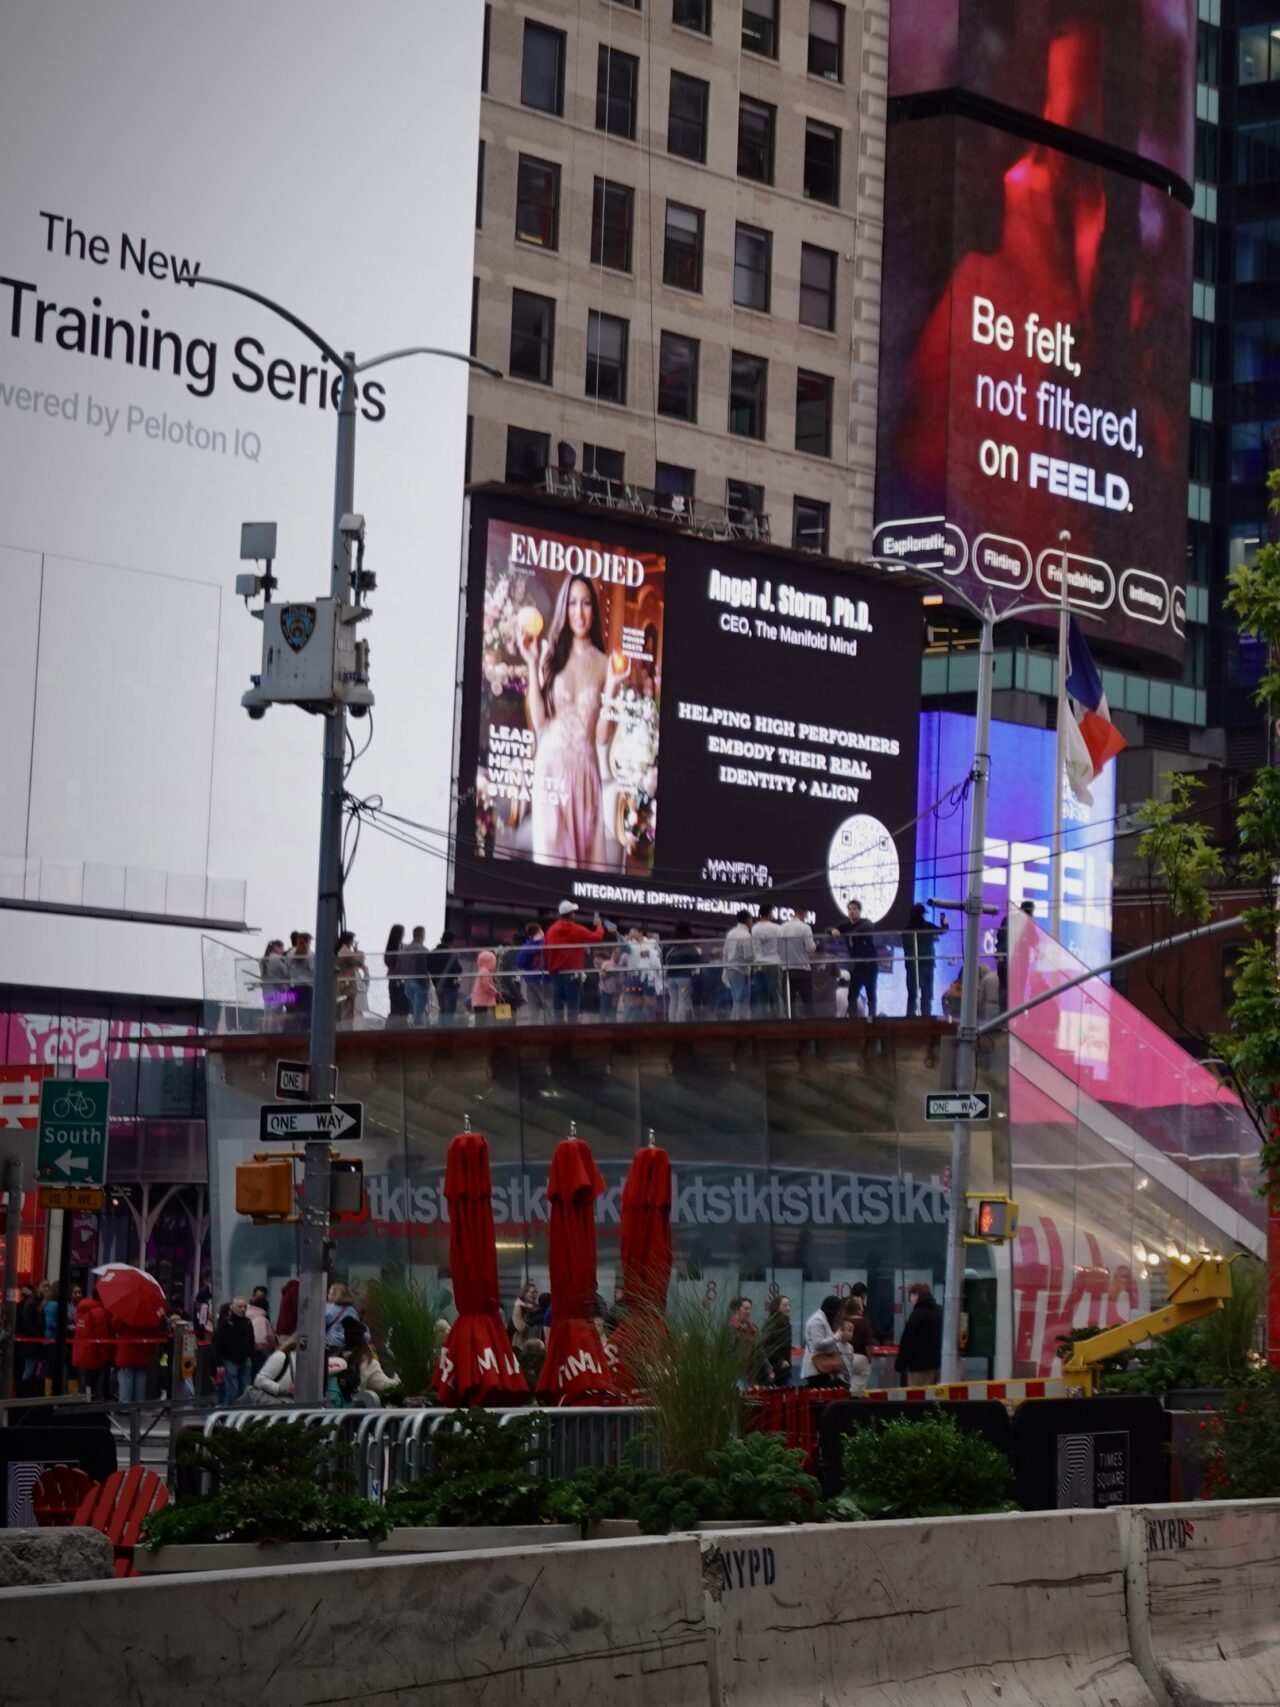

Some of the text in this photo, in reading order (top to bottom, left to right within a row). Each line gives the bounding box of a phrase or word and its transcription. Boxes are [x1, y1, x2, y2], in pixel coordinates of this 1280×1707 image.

[39, 210, 201, 287] The New
[0, 276, 217, 397] Training
[972, 296, 1081, 377] Be felt,
[87, 386, 119, 437] by
[127, 405, 227, 455] Peloton
[235, 430, 262, 464] IQ
[976, 373, 1144, 459] not filtered,
[979, 439, 1134, 512] on FEELD.
[509, 532, 645, 587] EMBODIED
[1047, 565, 1104, 594] Frindships
[709, 569, 873, 632] Angel J. Storm, Ph.D.
[720, 613, 857, 656] CEO, The Manifold Mind
[489, 724, 534, 744] LEAD
[678, 702, 751, 730] HELPING
[755, 715, 795, 738] HIGH
[799, 723, 900, 756] PERFORMERS
[488, 739, 532, 756] WITH
[488, 753, 535, 774] HEAR
[708, 735, 872, 781] EMBODY THEIR REAL
[487, 781, 570, 807] STRATGY
[488, 768, 566, 792] WIN WTH
[719, 766, 796, 793] IDENTITY
[810, 781, 859, 804] ALIGN
[573, 882, 645, 905] INTEGRATIVE
[283, 1073, 300, 1088] ONE
[271, 1115, 345, 1131] ONE WAY
[932, 1101, 979, 1113] ONE WAY
[43, 1127, 101, 1145] South
[1099, 1451, 1123, 1468] TIMES
[1096, 1470, 1126, 1489] SQUARE
[1147, 1519, 1190, 1552] NYPD
[721, 1547, 776, 1591] NYPD
